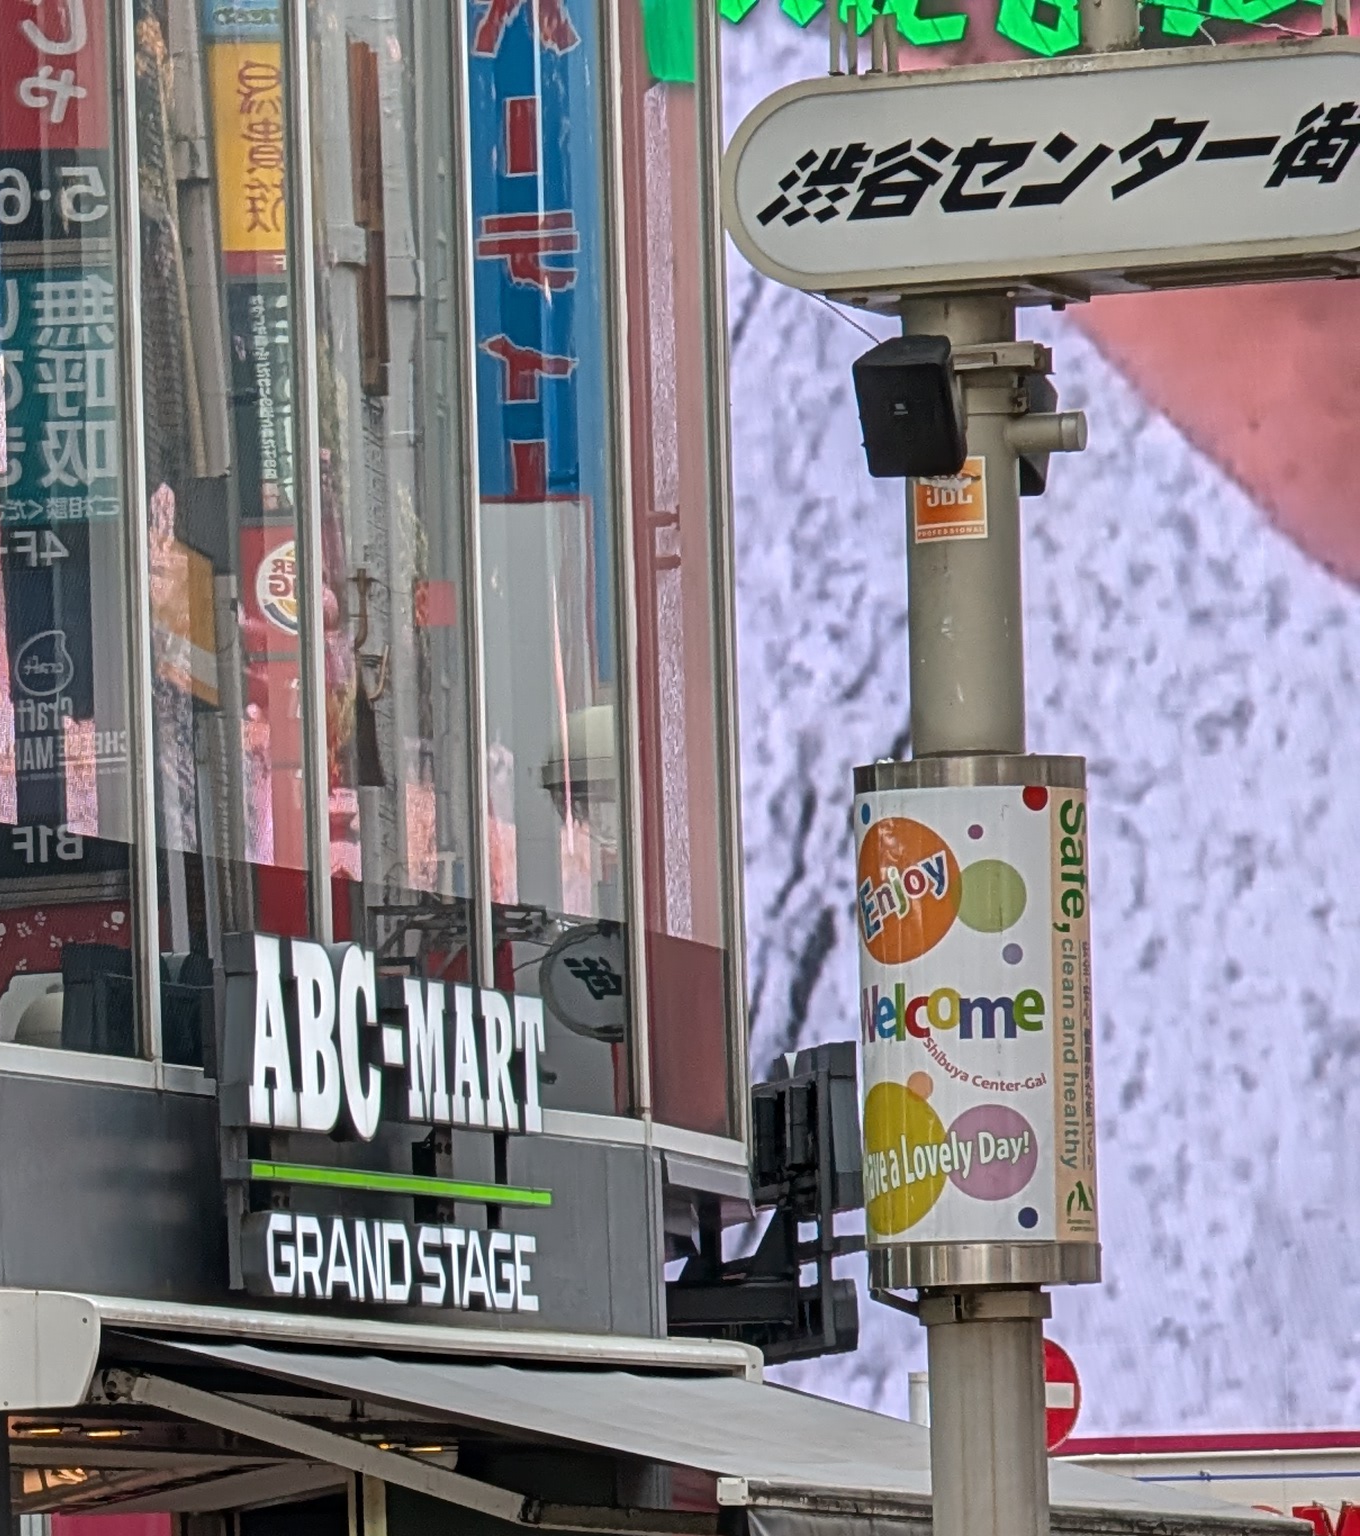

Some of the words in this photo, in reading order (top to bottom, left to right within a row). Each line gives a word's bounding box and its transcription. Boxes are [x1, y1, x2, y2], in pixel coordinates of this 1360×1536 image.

[756, 101, 1360, 227] 渋谷センター街
[917, 525, 984, 538] PROFESSIONAL
[858, 850, 948, 944] Enjoy
[248, 932, 547, 1141] ABC-MART
[862, 983, 1046, 1046] Welcome
[1064, 1016, 1079, 1065] and
[922, 1037, 970, 1082] Shibuya
[900, 1131, 973, 1184] Lovely
[977, 1129, 1030, 1166] Day!
[1058, 1068, 1081, 1172] healthy
[265, 1212, 413, 1304] GRAND
[417, 1225, 541, 1313] STAGE
